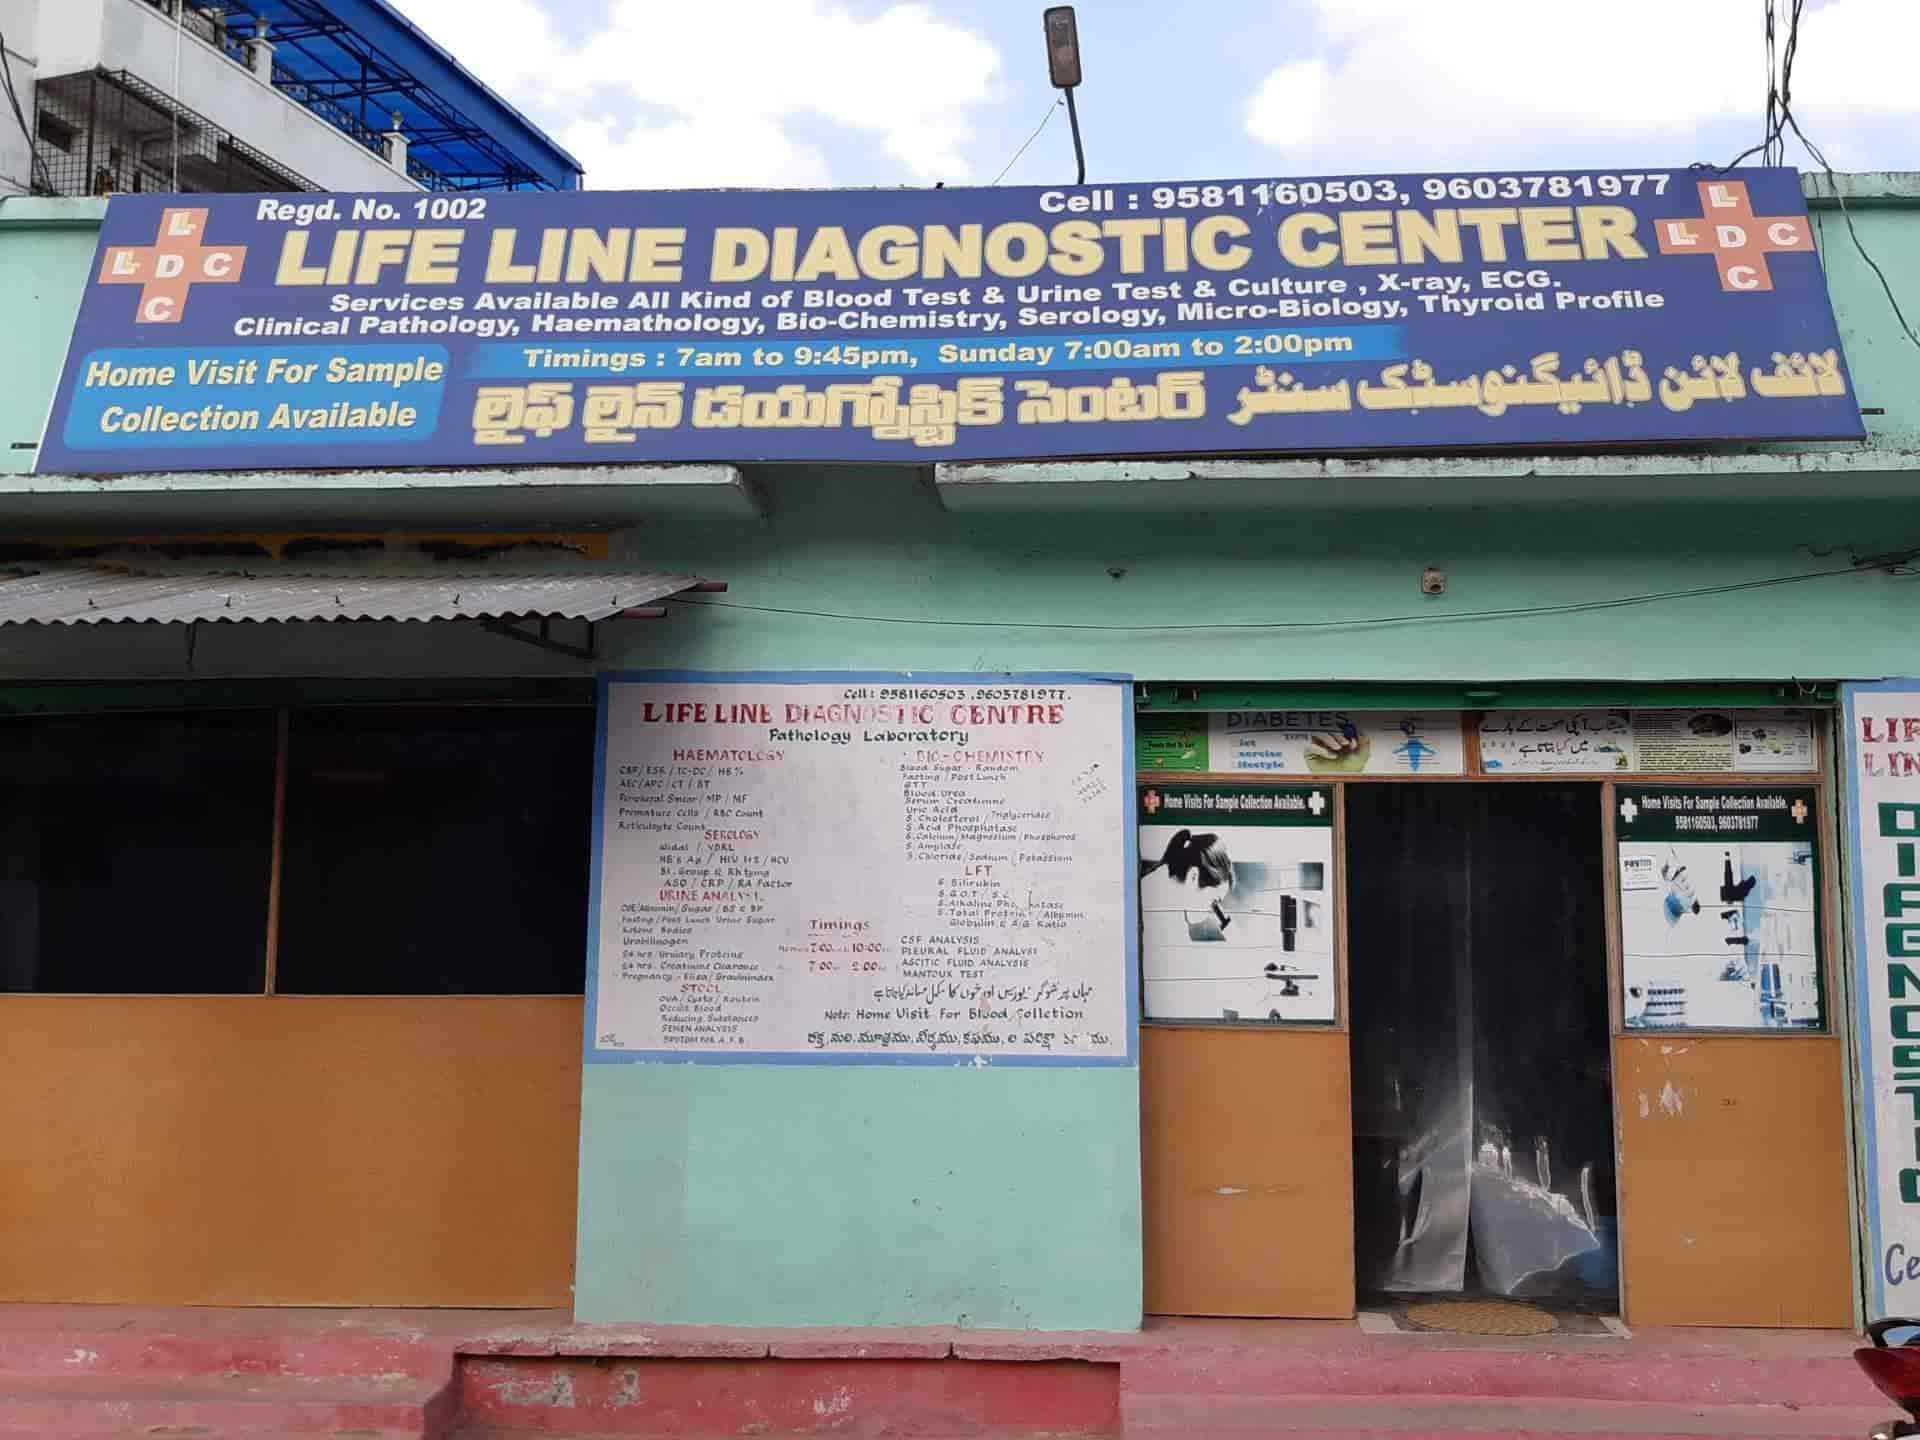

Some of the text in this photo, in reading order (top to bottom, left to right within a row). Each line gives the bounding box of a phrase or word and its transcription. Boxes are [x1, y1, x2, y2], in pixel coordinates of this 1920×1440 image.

[1039, 173, 1671, 214] Cell 9581160503, 9603781977
[256, 198, 487, 226] Regd. No. 1002
[275, 205, 1649, 287] LIFE LINE DIAGNOSTIC CENTER
[329, 294, 464, 313] Services
[474, 291, 619, 311] Available
[627, 291, 669, 310] All
[680, 290, 751, 310] Kind
[760, 289, 793, 309] of
[804, 288, 892, 308] Blood
[902, 287, 971, 307] Test
[982, 286, 1005, 304] &
[1016, 284, 1103, 304] Urine
[1112, 281, 1183, 301] Test
[1192, 279, 1216, 298] &
[1377, 272, 1471, 294] X-ray,
[1481, 269, 1562, 290] ECG.
[233, 289, 1666, 338] Clinical Pathology, Haemathology, Bio-Chemistry, Serology, Micro-Biology, Thyroid Profile
[523, 334, 1353, 373] Timings 7am to 9:45pm, Sunday 7:00am to 2:00pm
[85, 355, 445, 389] Home Visit For Sample
[99, 401, 417, 434] Collection Available
[471, 381, 575, 446] లైఫ్
[581, 380, 686, 444] లైన్
[950, 703, 1065, 725] CENTRE
[769, 727, 969, 746] Pathology Laboratory
[1163, 793, 1183, 809] Home
[1184, 793, 1203, 809] Visits
[1203, 793, 1214, 809] For
[1215, 793, 1239, 813] Sample
[1239, 794, 1273, 809] Collection
[1641, 794, 1662, 809] Home
[1662, 795, 1682, 809] Visits
[1683, 795, 1694, 809] For
[1695, 795, 1720, 813] Sample
[1721, 795, 1755, 809] Collection
[964, 864, 993, 877] LFT
[946, 958, 975, 968] FLUID
[959, 970, 985, 979] TEST
[856, 1009, 891, 1020] Home
[895, 1007, 929, 1020] Visit
[939, 1008, 961, 1020] For
